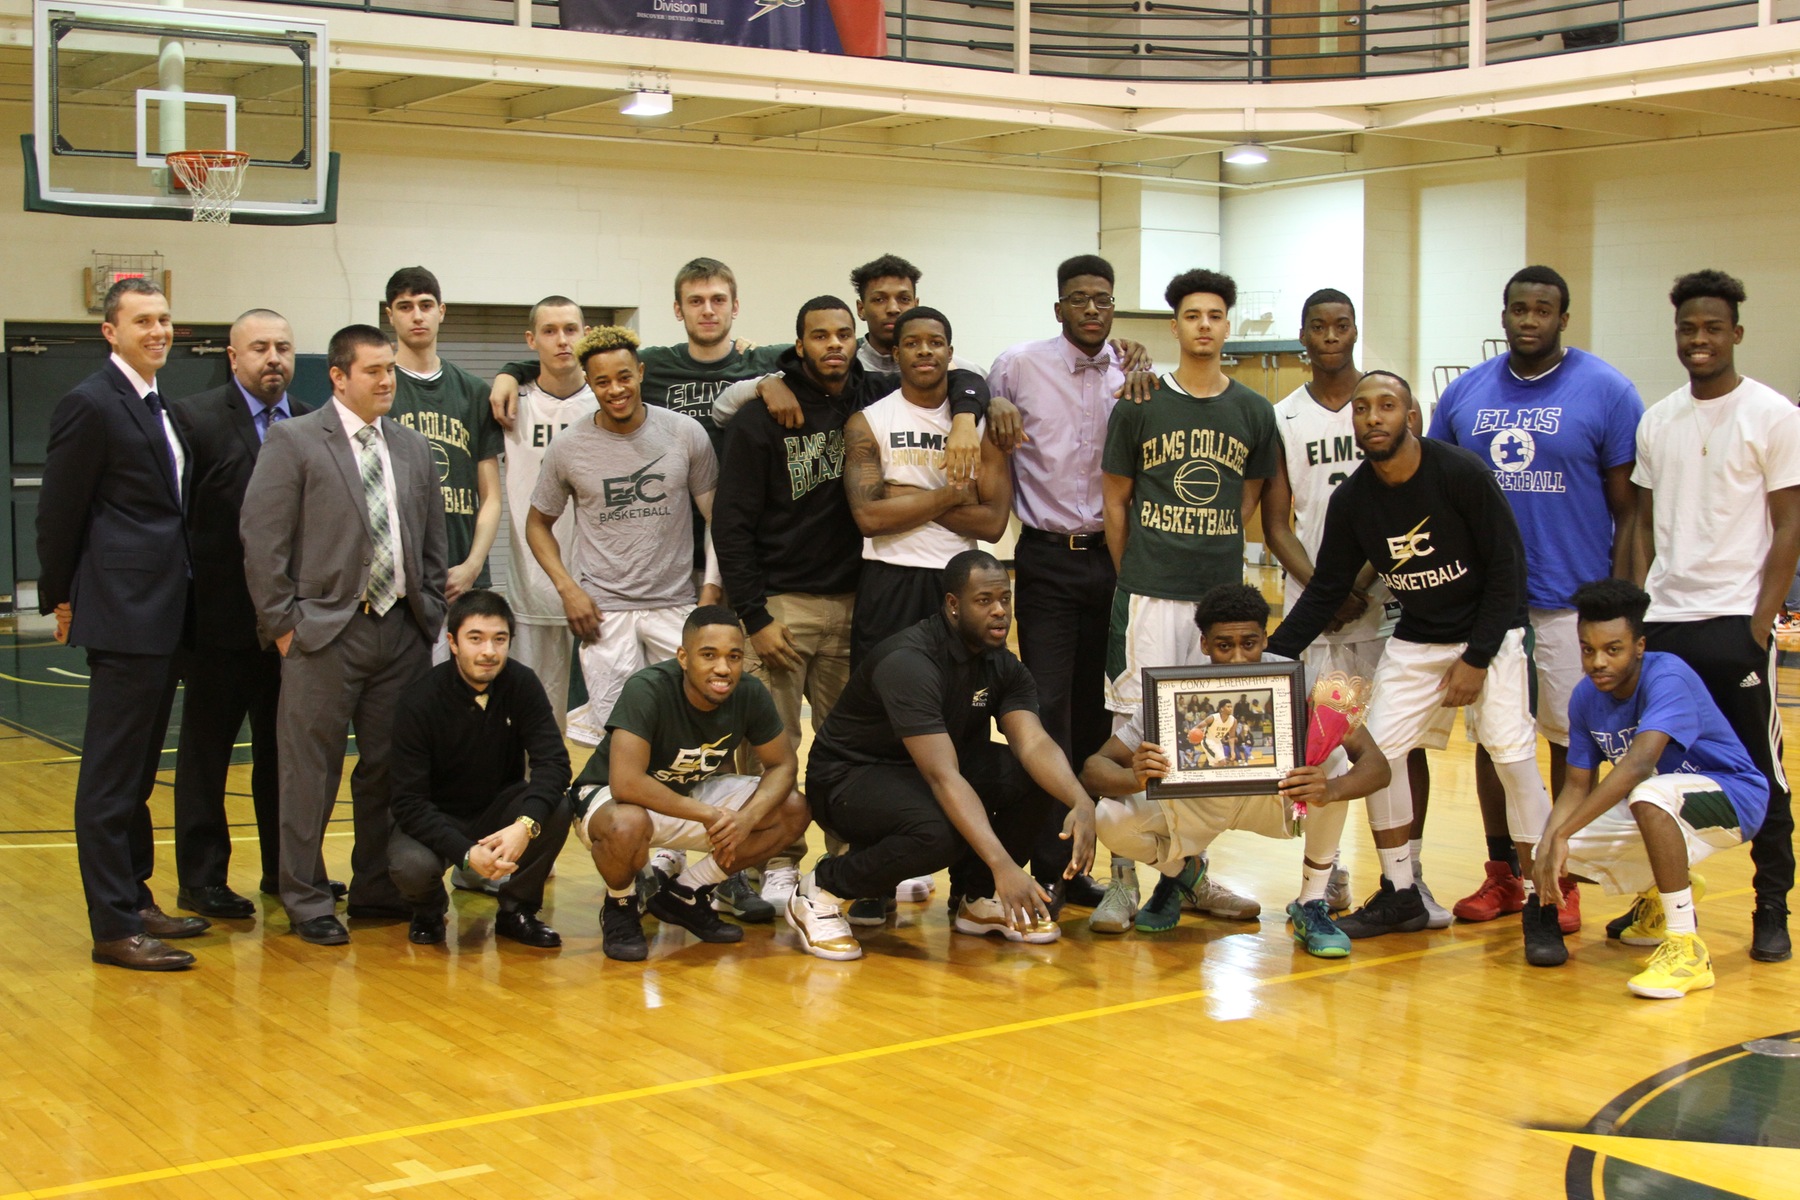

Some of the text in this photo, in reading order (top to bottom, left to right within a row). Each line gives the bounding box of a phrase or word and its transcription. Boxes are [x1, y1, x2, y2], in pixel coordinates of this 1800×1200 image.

[636, 12, 665, 20] DISCOVER
[697, 17, 725, 25] DEDICATE
[653, 0, 708, 15] Division III
[1472, 407, 1562, 436] ELMS
[784, 431, 827, 463] ELMS
[1143, 428, 1249, 477] ELMS COLLEGE
[602, 472, 668, 509] EC
[600, 506, 671, 524] BASKETBALL
[1141, 500, 1239, 536] BASKETBALL
[1386, 531, 1436, 560] EC
[1378, 559, 1468, 591] BASKETBALL
[1180, 679, 1211, 690] CONNY
[669, 746, 729, 773] EC
